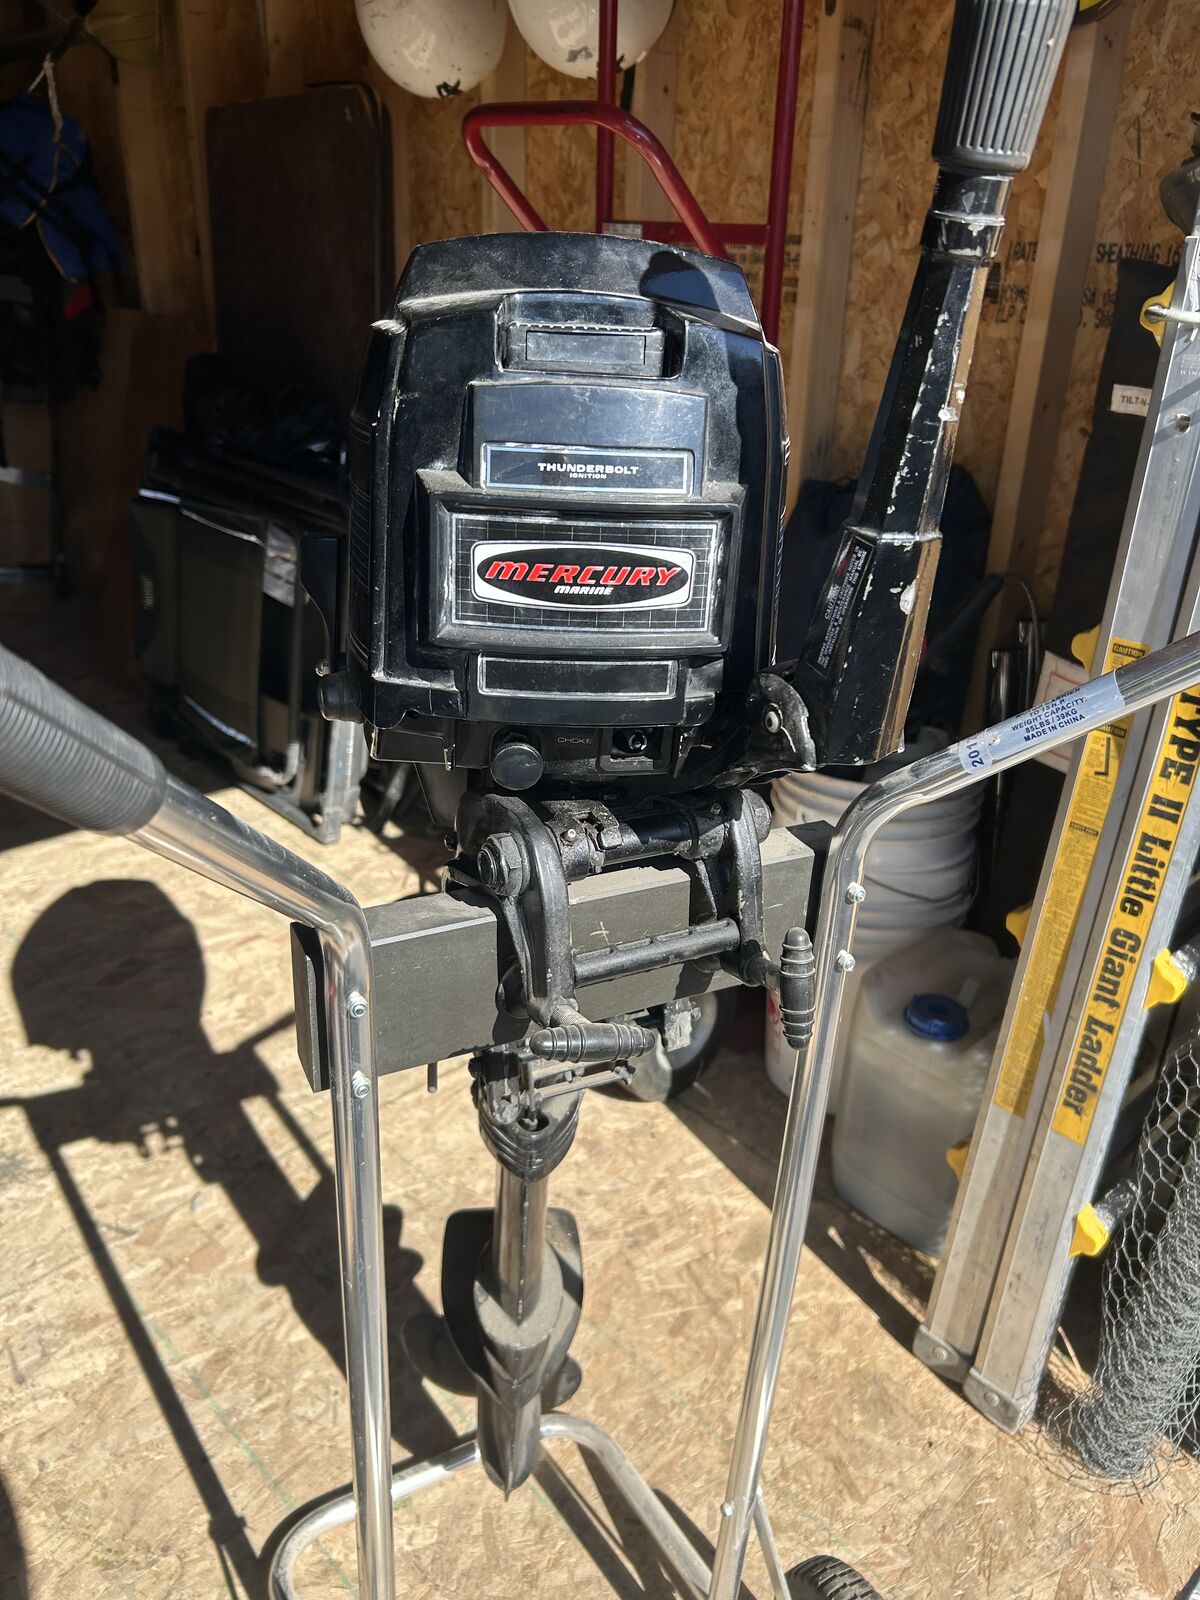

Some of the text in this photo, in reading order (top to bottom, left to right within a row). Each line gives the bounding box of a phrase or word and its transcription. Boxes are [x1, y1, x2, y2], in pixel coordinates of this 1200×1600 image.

[1096, 242, 1161, 264] SHEATHING
[537, 462, 639, 475] THUNDERBOLT
[484, 560, 682, 586] MERCURY
[553, 584, 614, 596] MARINE
[824, 584, 841, 619] CAUTION
[1113, 644, 1144, 658] CAUTION
[1011, 714, 1043, 731] WEIGHT
[1044, 695, 1087, 717] CAPACITY:
[1023, 712, 1085, 742] MADE IN CHINA
[1024, 718, 1050, 733] 85LBS
[1055, 707, 1077, 721] 39KG
[1119, 831, 1173, 917] Little
[1092, 927, 1142, 1010] Giant
[1065, 1014, 1115, 1117] Ladder
